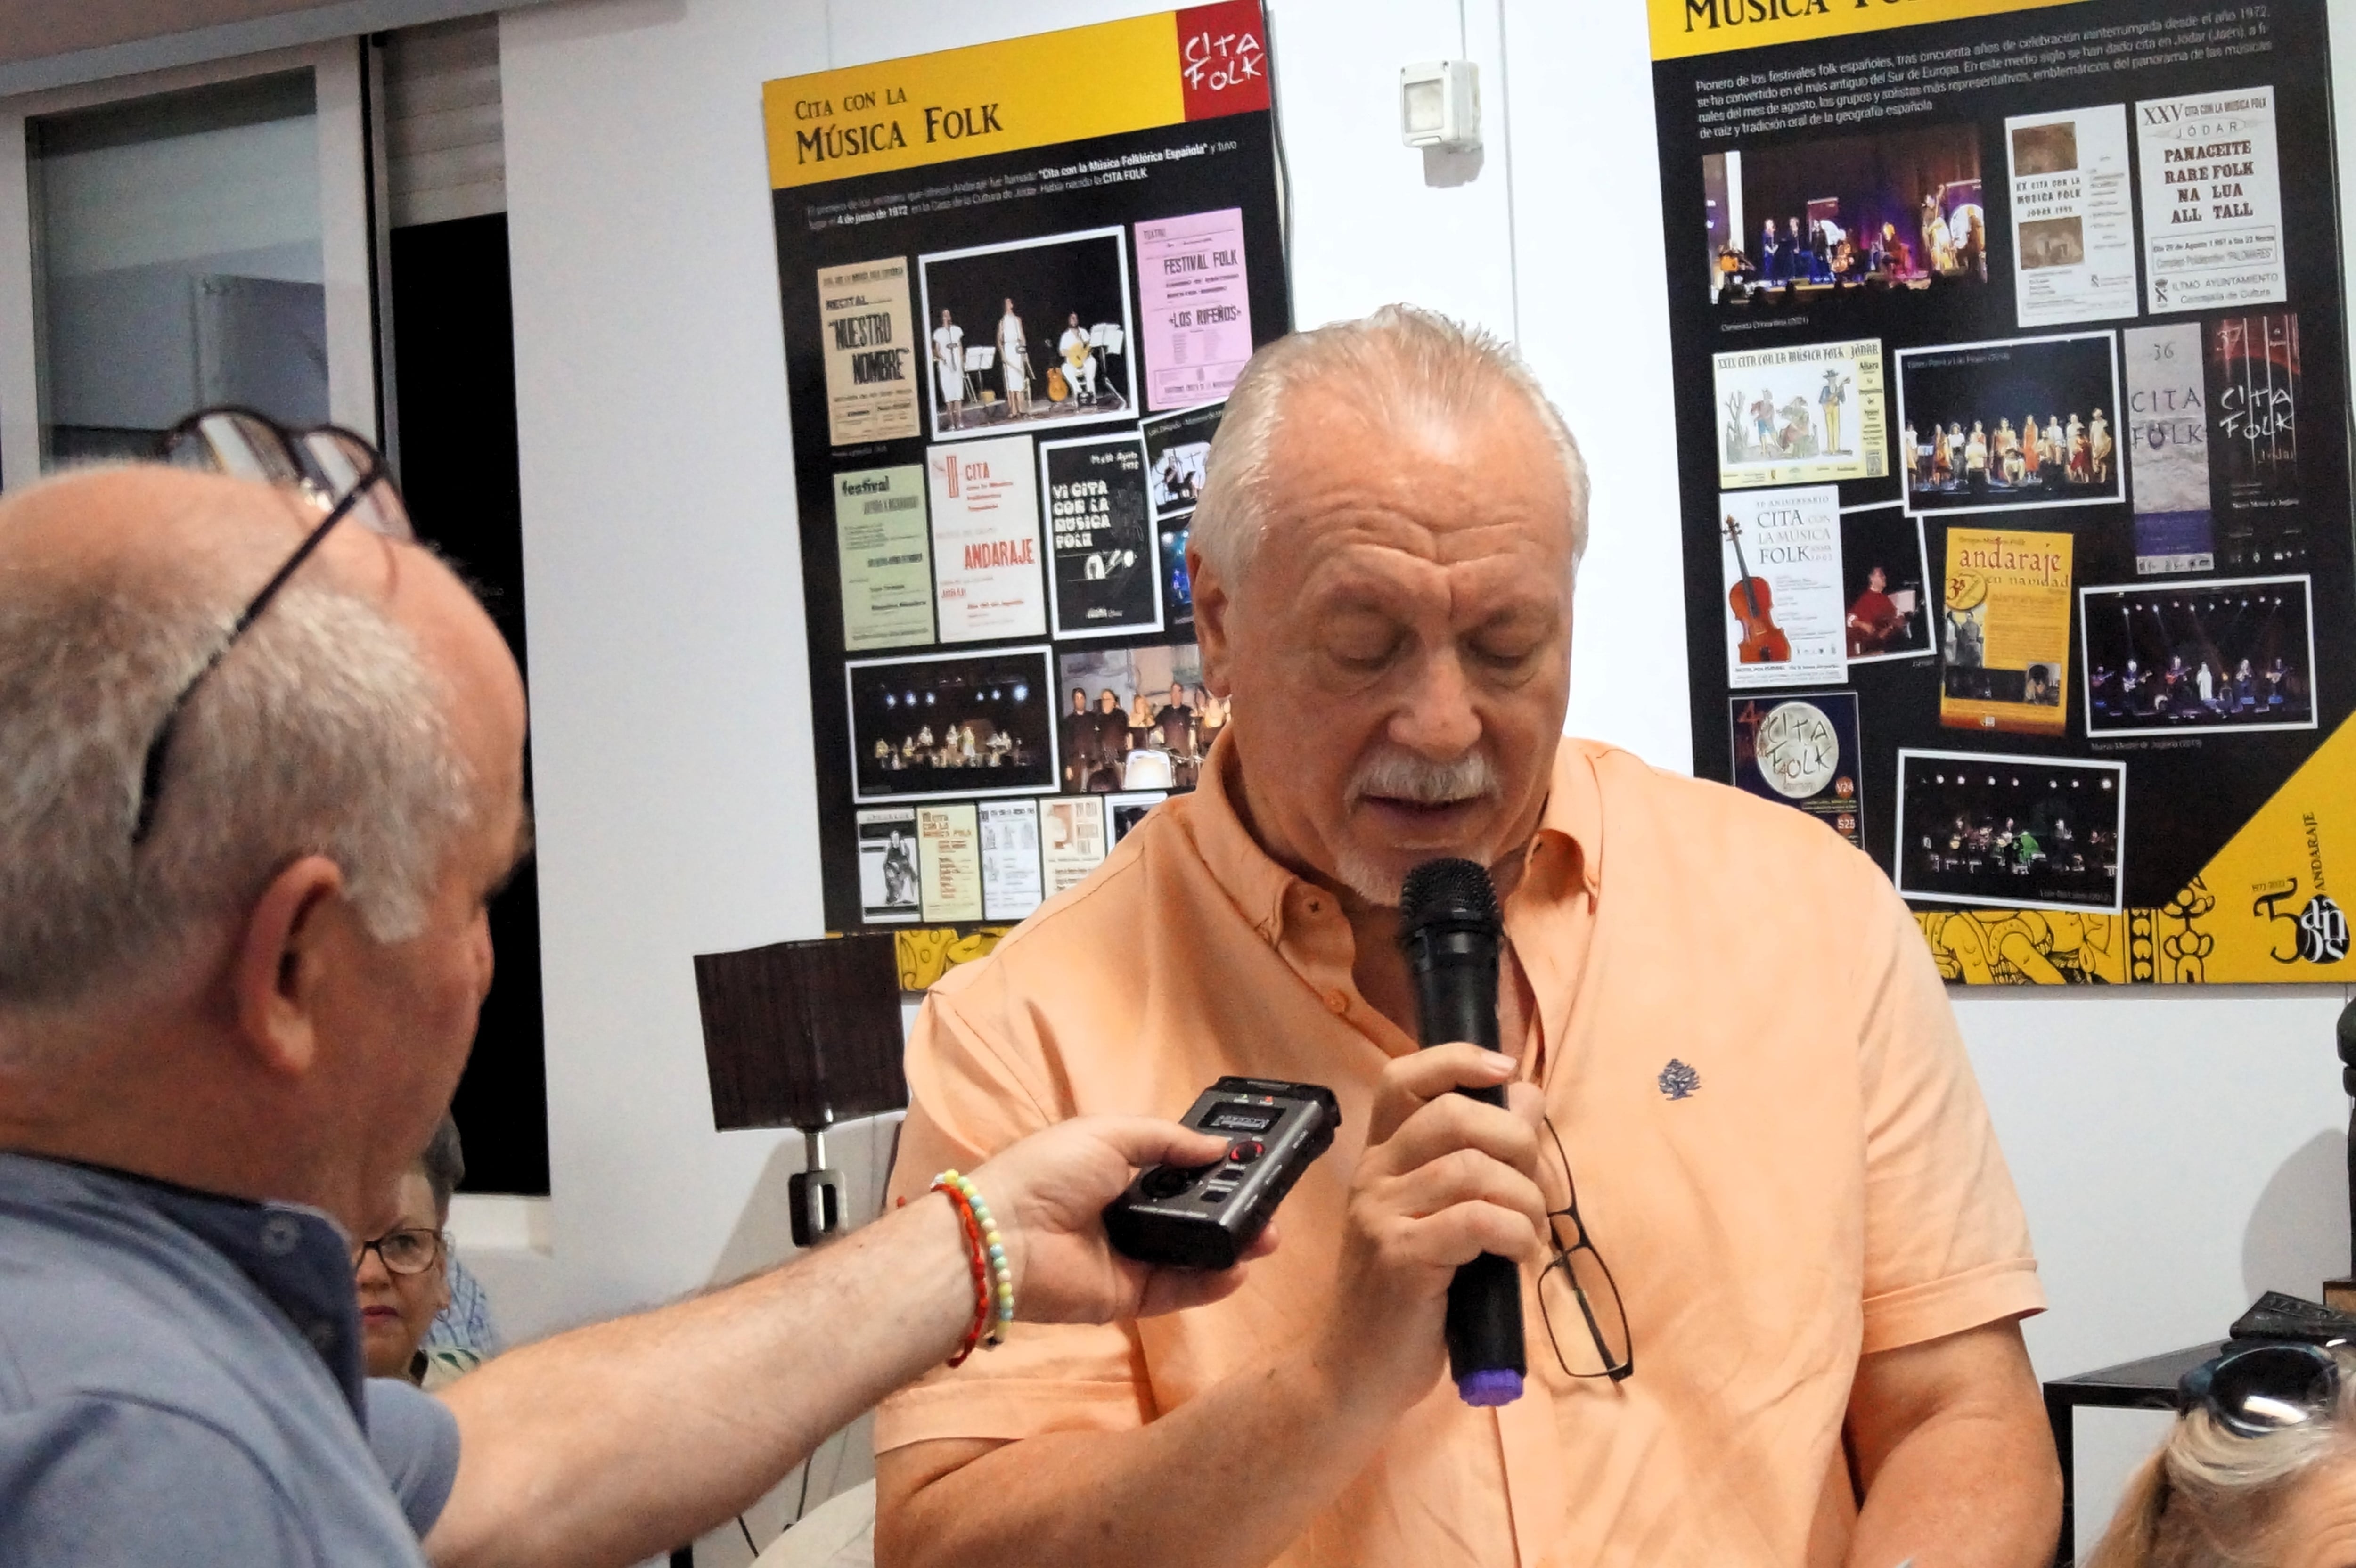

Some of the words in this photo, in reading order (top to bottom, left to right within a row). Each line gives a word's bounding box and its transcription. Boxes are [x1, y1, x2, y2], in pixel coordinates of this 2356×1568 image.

[1185, 32, 1260, 62] CITA
[1184, 53, 1264, 90] FOLK
[1695, 78, 1734, 92] Pionero
[1736, 75, 1749, 87] de
[1751, 74, 1767, 85] los
[1769, 66, 1817, 83] festivales
[1818, 62, 1838, 76] folk
[1897, 53, 1918, 66] tras
[1919, 46, 1972, 62] cincuenta
[1710, 94, 1725, 106] ha
[1725, 87, 1779, 105] convertido
[1779, 86, 1793, 97] en
[1793, 83, 1804, 95] el
[1829, 76, 1868, 90] antiguo
[1870, 72, 1886, 86] del
[1886, 71, 1905, 83] Sur
[1907, 68, 1920, 81] de
[1698, 110, 1726, 123] nales
[1726, 107, 1742, 120] del
[1766, 103, 1779, 114] de
[1836, 91, 1873, 108] grupos
[1873, 91, 1881, 104] y
[2143, 103, 2183, 126] XXV
[796, 120, 908, 164] MÚSICA
[924, 103, 1003, 143] FOLK
[1734, 125, 1741, 137] y
[1742, 118, 1787, 134] tradición
[1787, 115, 1807, 128] oral
[1809, 113, 1823, 125] de
[1824, 111, 1833, 122] la
[2176, 121, 2237, 139] JÓDAR
[1061, 165, 1078, 176] con
[1079, 161, 1088, 173] la
[1088, 158, 1120, 172] Música
[1121, 151, 1163, 167] Folklórica
[2163, 140, 2252, 164] PANACEITE
[2164, 166, 2209, 185] RARE
[2211, 161, 2255, 180] FOLK
[844, 213, 855, 224] de
[876, 209, 886, 219] de
[1103, 171, 1122, 184] CITA
[1124, 167, 1148, 180] FOLK
[2177, 187, 2201, 204] NA
[2211, 182, 2244, 200] LUA
[2170, 207, 2203, 225] ALL
[2212, 203, 2254, 220] TALL
[1163, 253, 1209, 276] FESTIVAL
[1213, 249, 1239, 269] FOLK
[828, 311, 892, 351] NUESTRO
[2152, 343, 2175, 362] 36
[852, 347, 910, 386] NOMBRE
[2131, 387, 2202, 414] CITA
[2220, 385, 2293, 411] CITA
[2131, 424, 2204, 449] FOLK
[2219, 410, 2295, 440] FOLK
[965, 462, 990, 481] CITA
[842, 475, 890, 497] festival
[1053, 498, 1086, 516] CON
[1757, 509, 1804, 528] CITA
[1759, 532, 1774, 545] LA
[964, 538, 1035, 571] ANDARAJE
[1759, 546, 1811, 564] FOLK
[1959, 536, 2061, 583] andaraje
[2009, 574, 2070, 588] navidad
[1768, 712, 1829, 743] CITA
[2302, 811, 2326, 892] ANDARAJE
